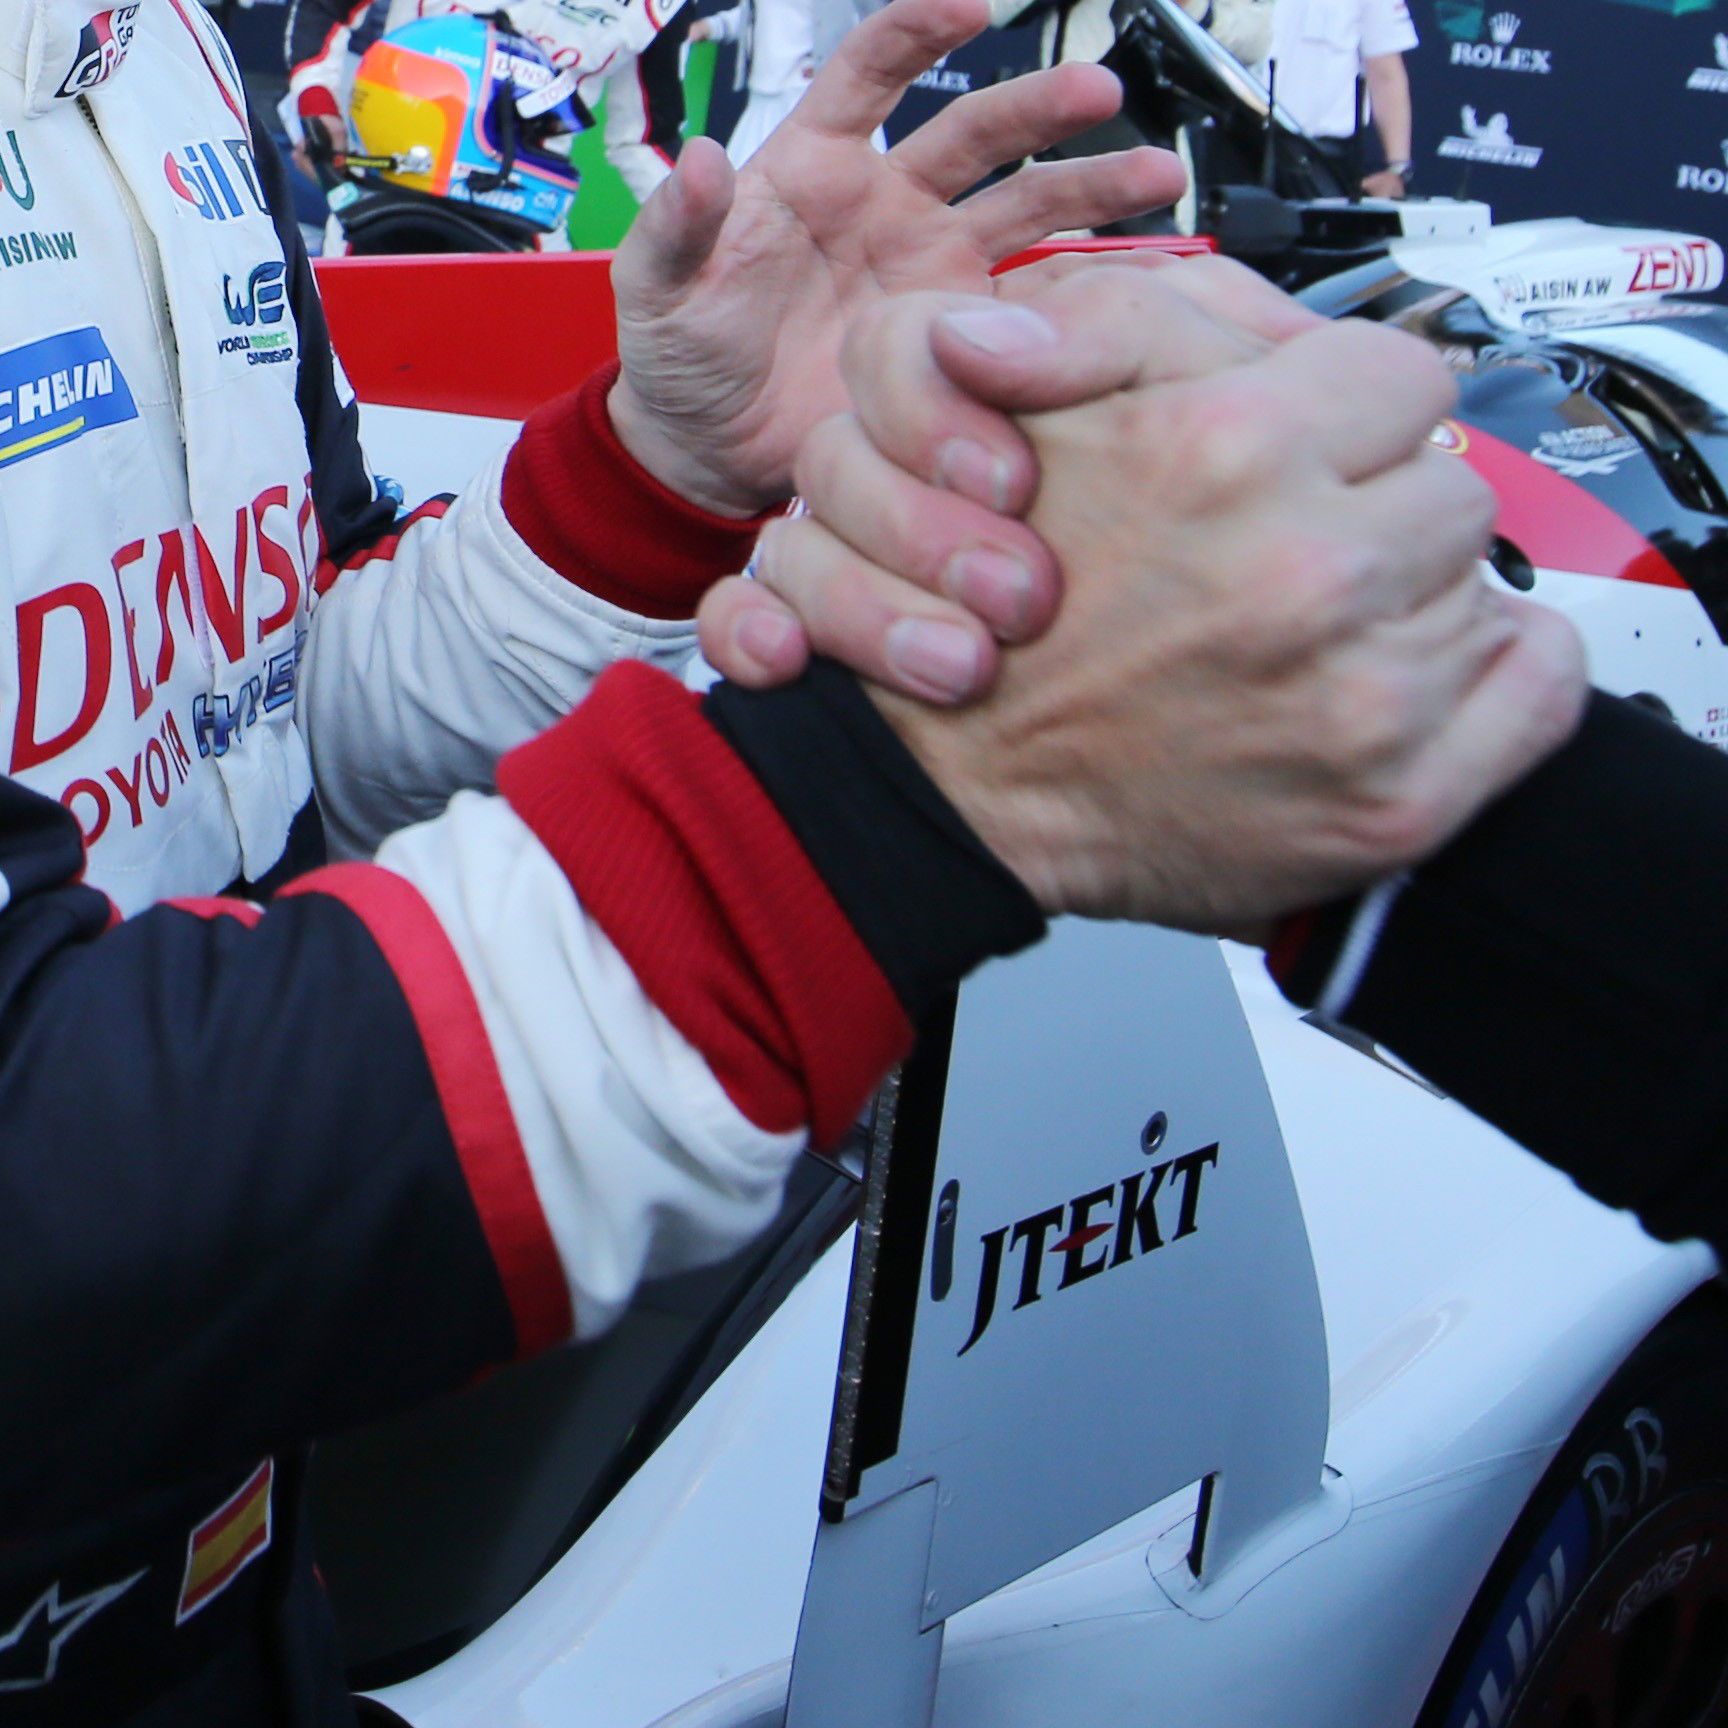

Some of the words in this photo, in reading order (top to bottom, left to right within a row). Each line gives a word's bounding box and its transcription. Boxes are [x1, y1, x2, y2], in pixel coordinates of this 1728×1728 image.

[1450, 41, 1551, 74] ROLEX
[1531, 278, 1577, 302] AISIN
[1584, 276, 1611, 301] AW
[1622, 241, 1708, 294] ZENT
[957, 1142, 1220, 1358] JTEKT
